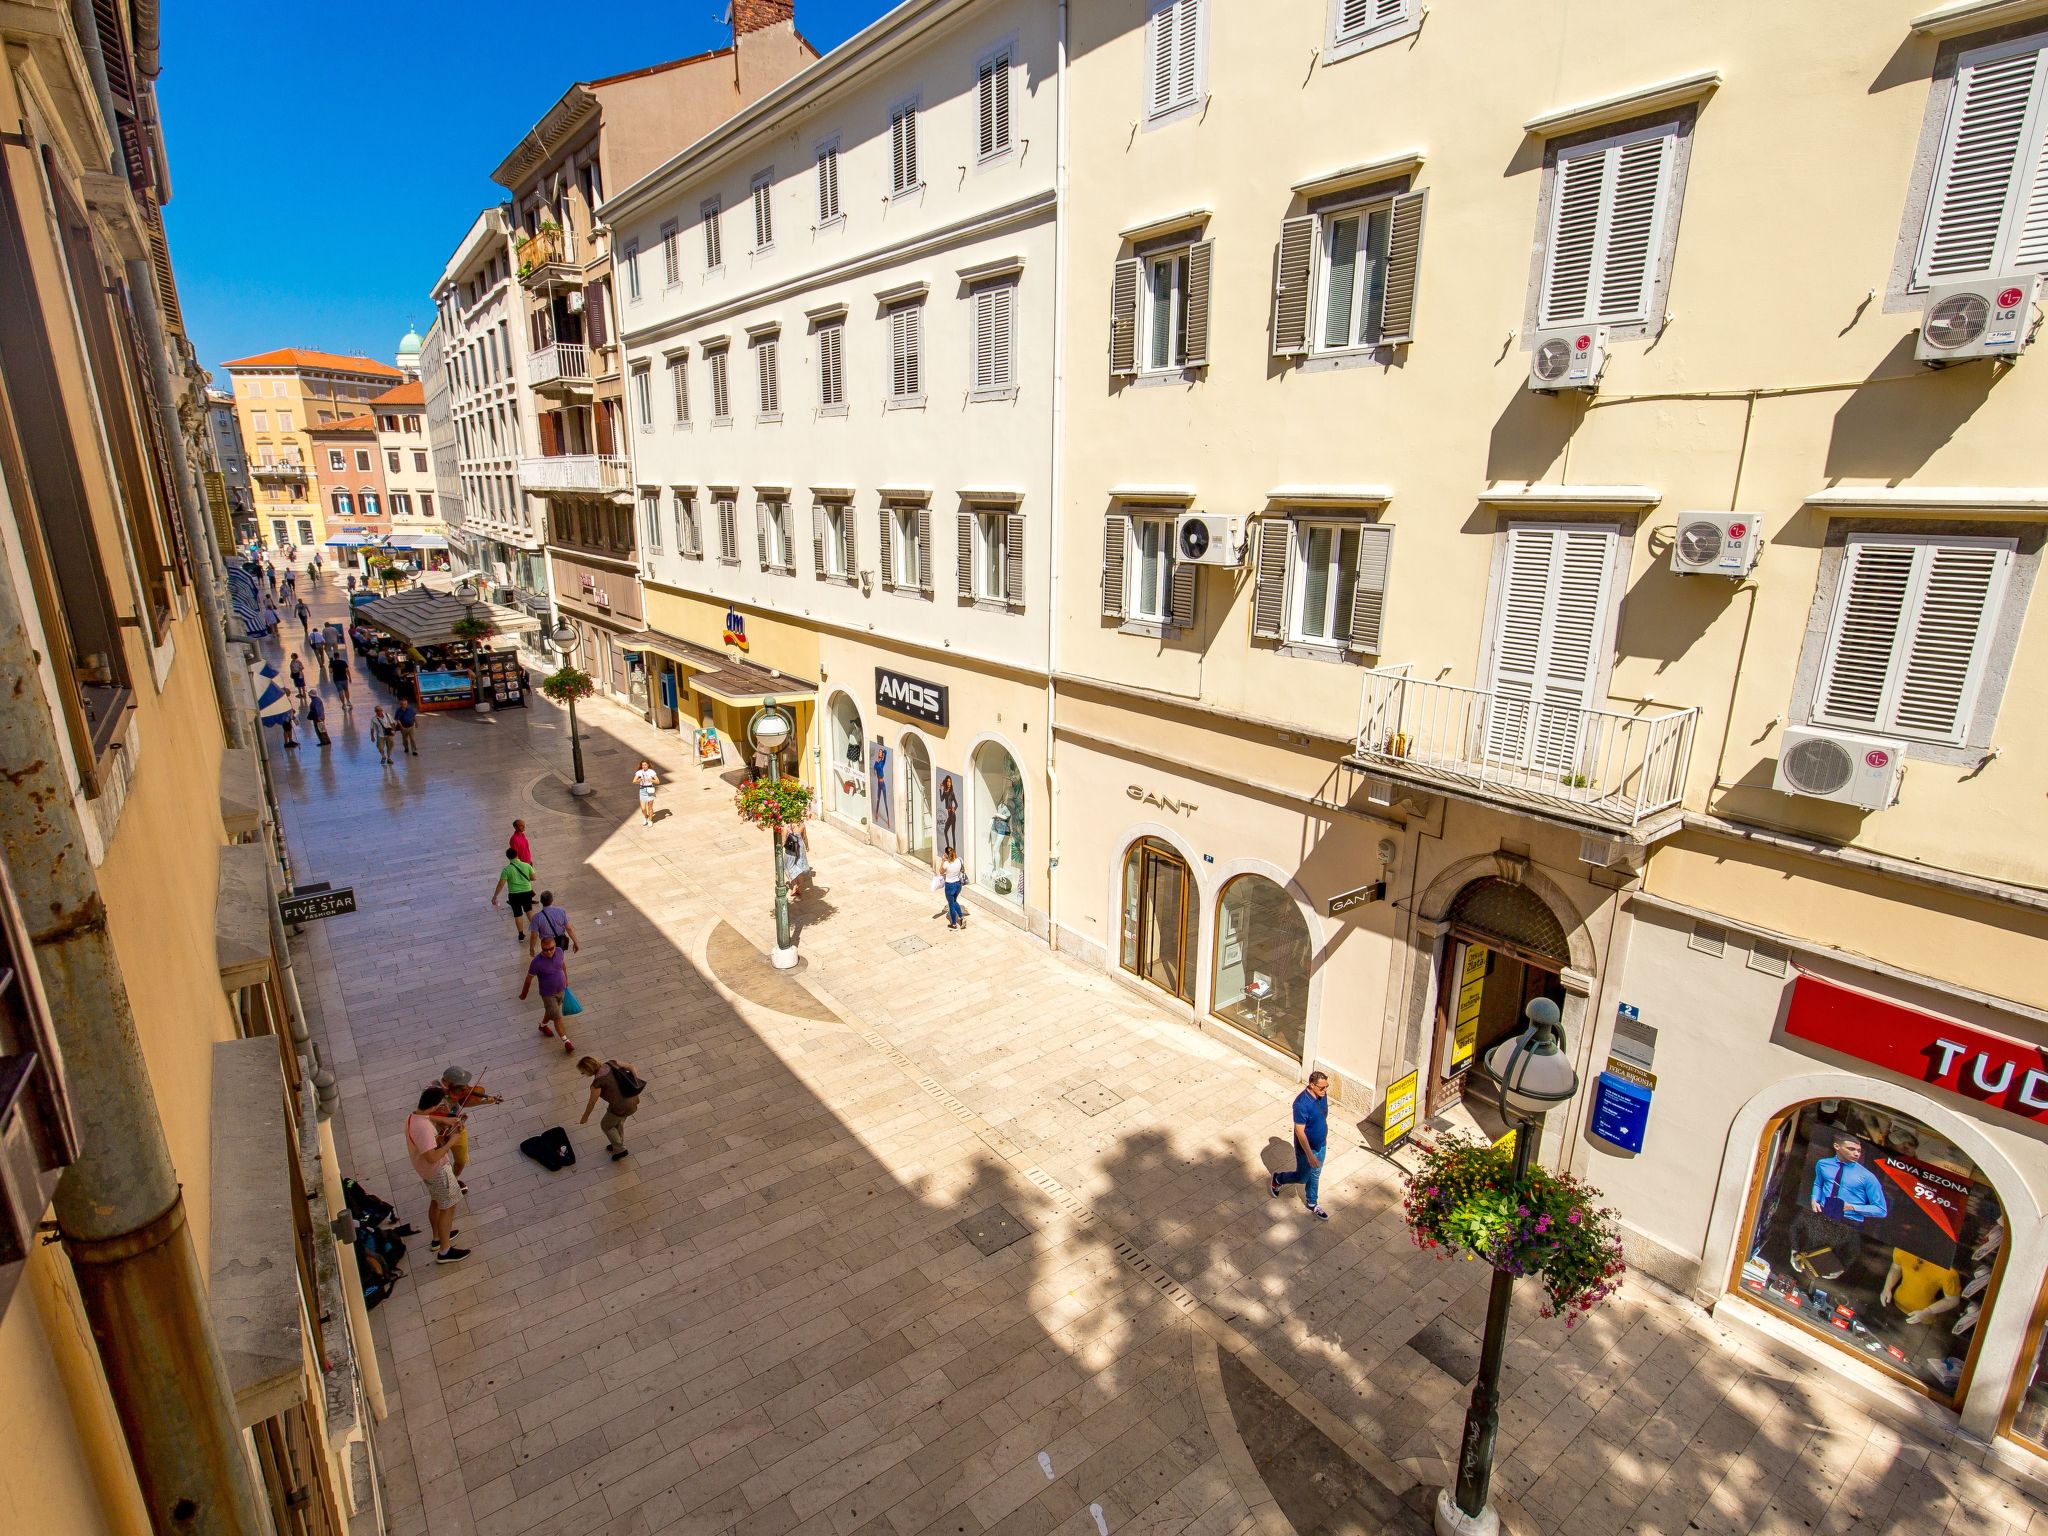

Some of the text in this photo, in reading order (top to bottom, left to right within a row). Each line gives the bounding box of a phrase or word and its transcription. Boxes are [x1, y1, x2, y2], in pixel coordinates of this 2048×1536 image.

[1996, 310, 2016, 321] LG
[1575, 352, 1587, 360] LG
[1727, 540, 1742, 549] LG
[726, 604, 746, 635] dm
[1126, 784, 1199, 818] GANT
[1332, 889, 1376, 911] GANT
[284, 897, 353, 918] FIVE STAR
[305, 910, 336, 920] FASHION
[1624, 1005, 1633, 1015] 2
[1609, 1064, 1626, 1077] IVICA
[1886, 1157, 1920, 1176] NOVA
[1922, 1170, 1969, 1195] SEZONA
